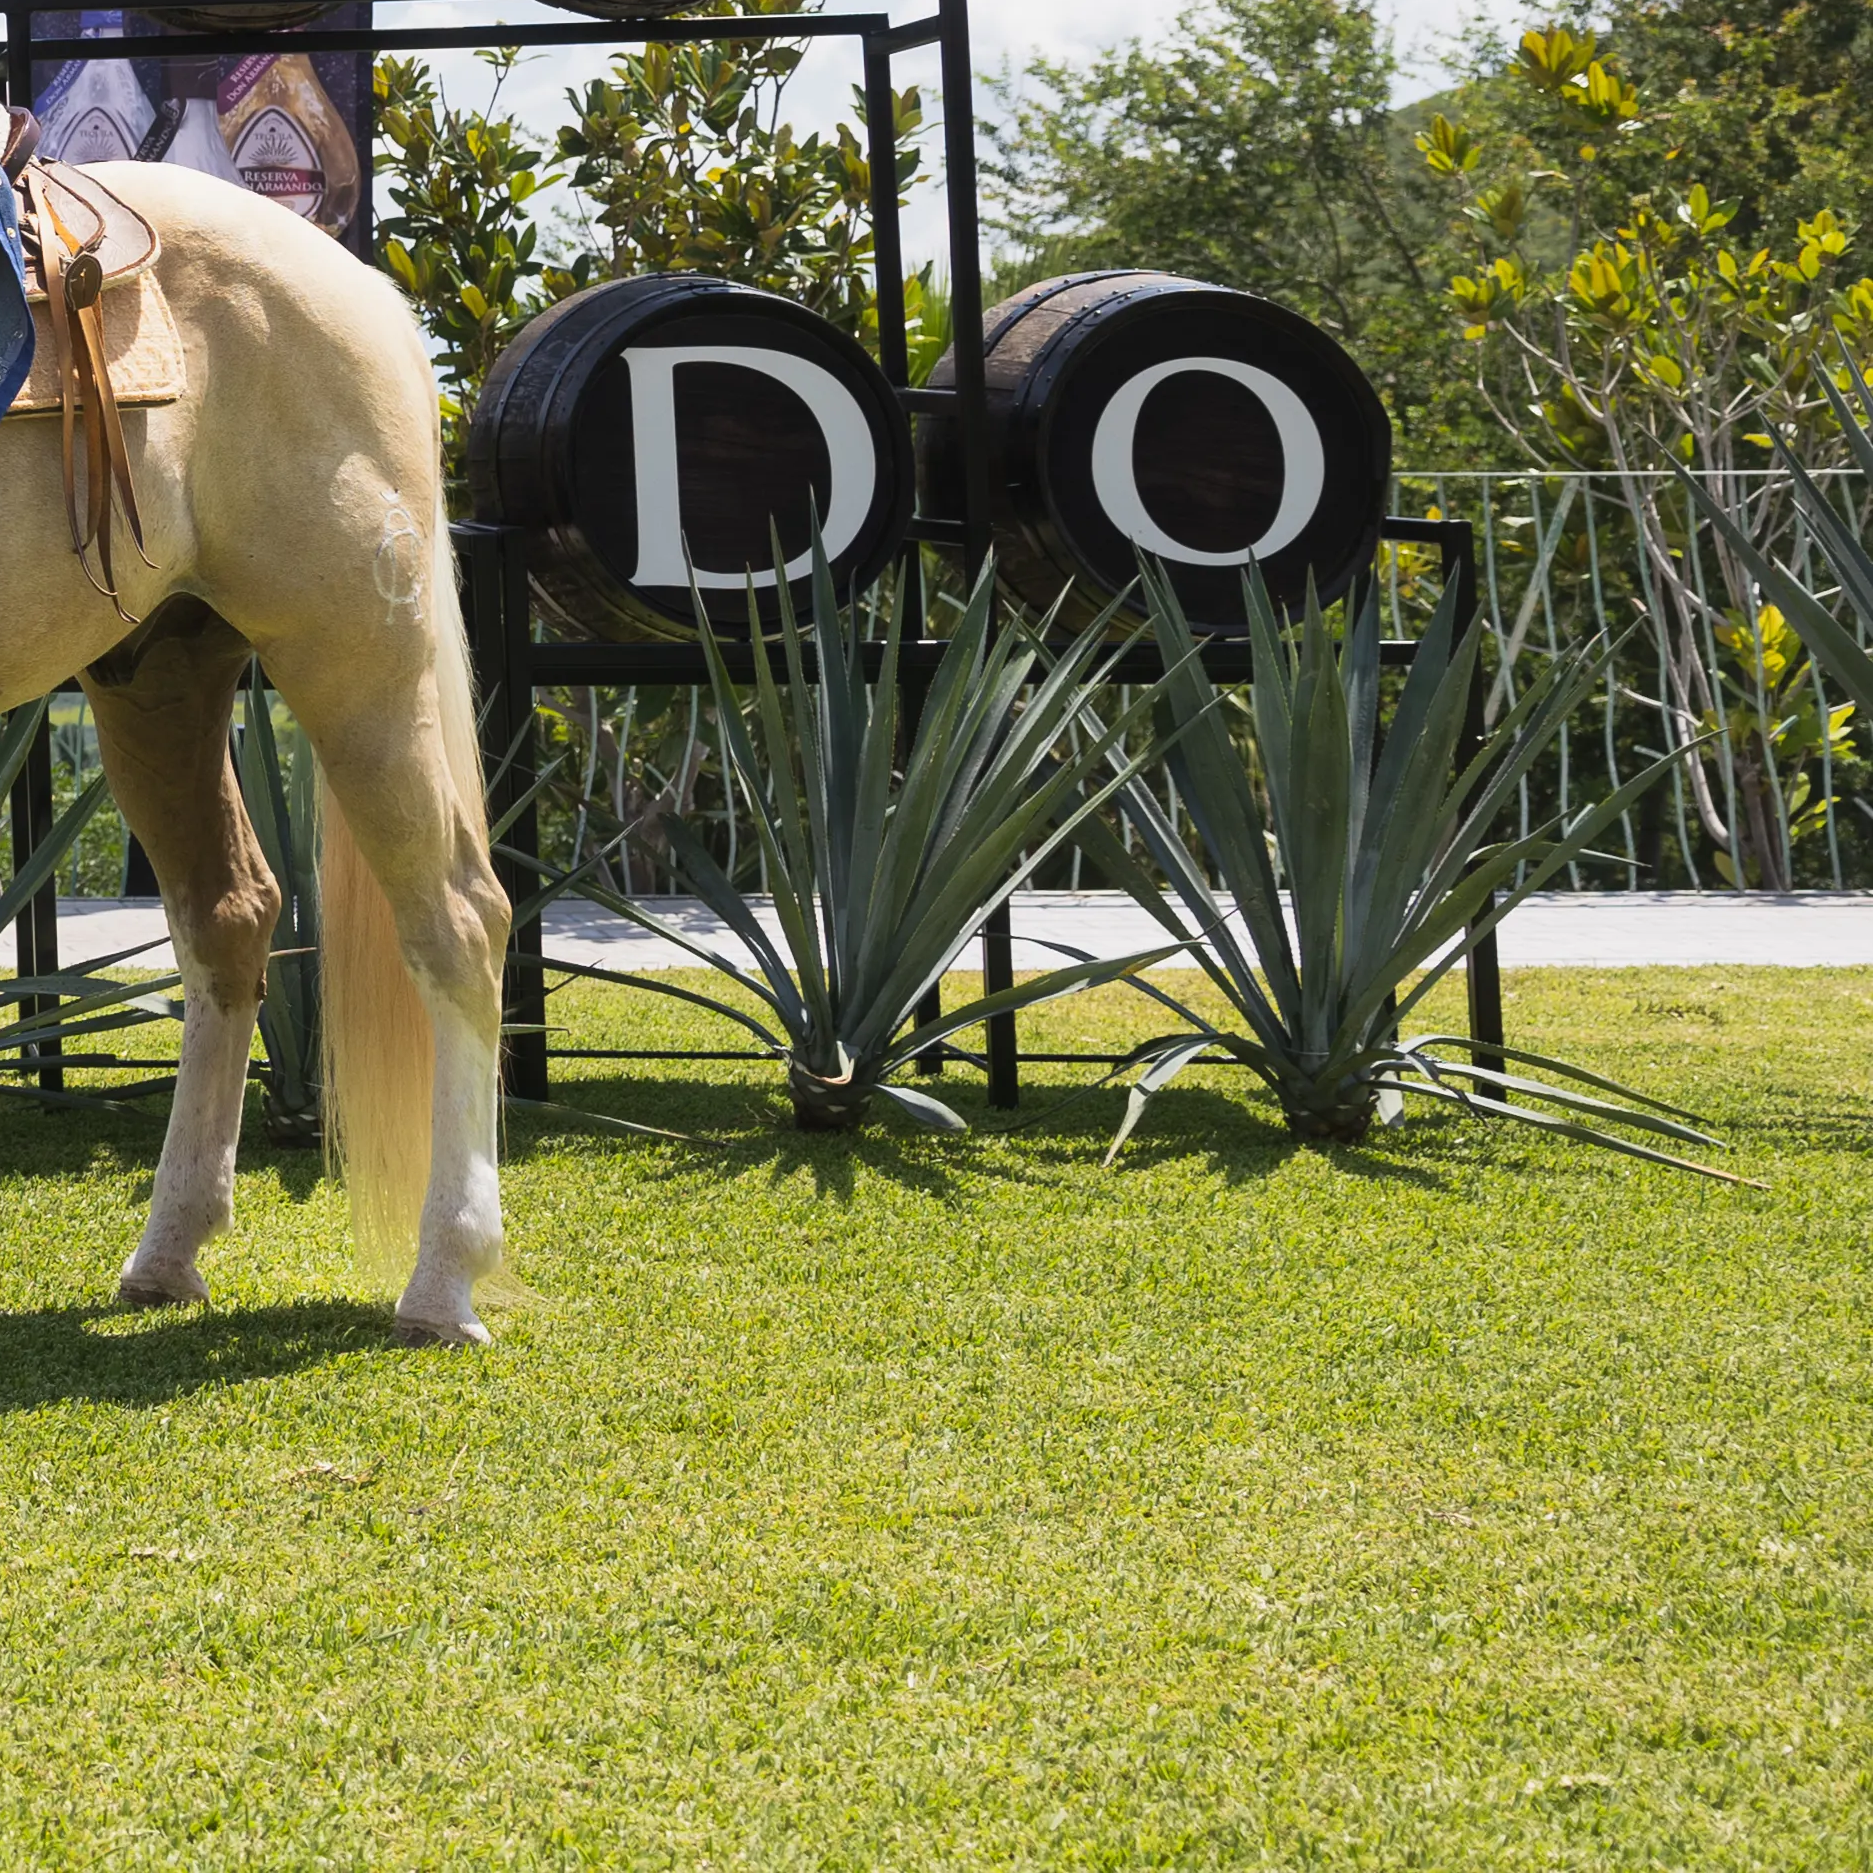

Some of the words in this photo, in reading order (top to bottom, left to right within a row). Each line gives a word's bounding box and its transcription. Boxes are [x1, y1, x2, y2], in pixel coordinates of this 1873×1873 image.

[226, 82, 247, 102] DON
[244, 54, 274, 84] ARMAN
[230, 54, 259, 83] RESERV
[244, 171, 299, 182] RESERVA
[255, 182, 323, 192] ARMANDO
